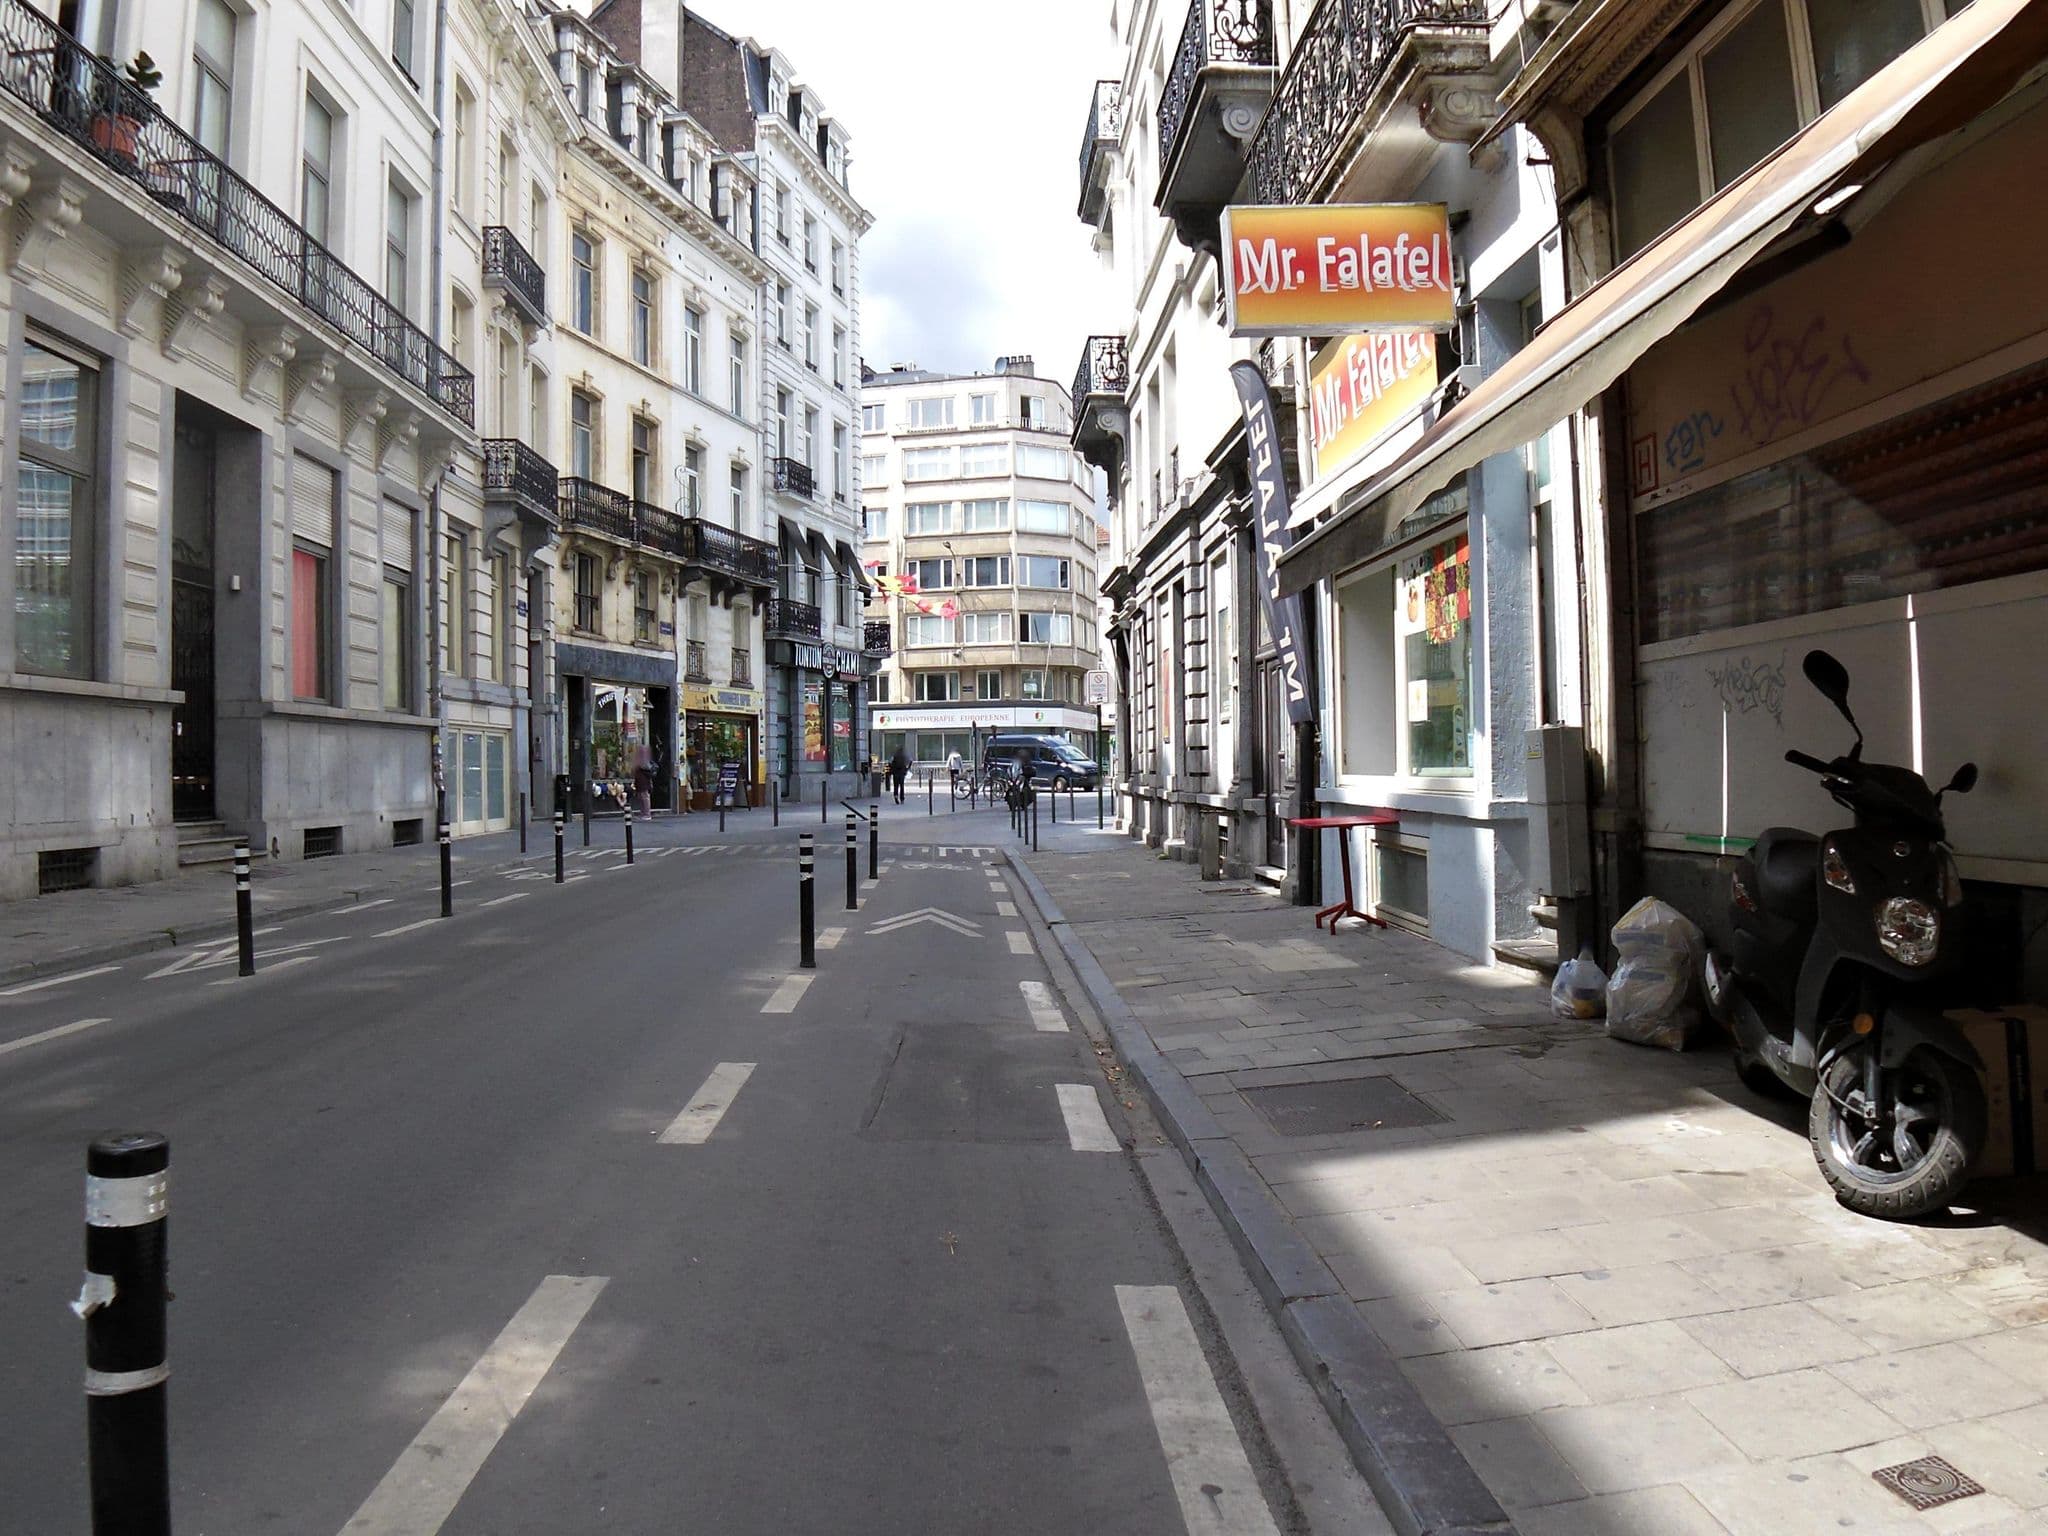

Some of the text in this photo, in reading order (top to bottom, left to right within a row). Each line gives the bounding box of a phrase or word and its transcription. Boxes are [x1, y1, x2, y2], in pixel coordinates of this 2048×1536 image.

[1238, 233, 1447, 291] Mr. Falafel
[1315, 373, 1347, 450] Mr.
[795, 644, 860, 675] TONTON CHAMI
